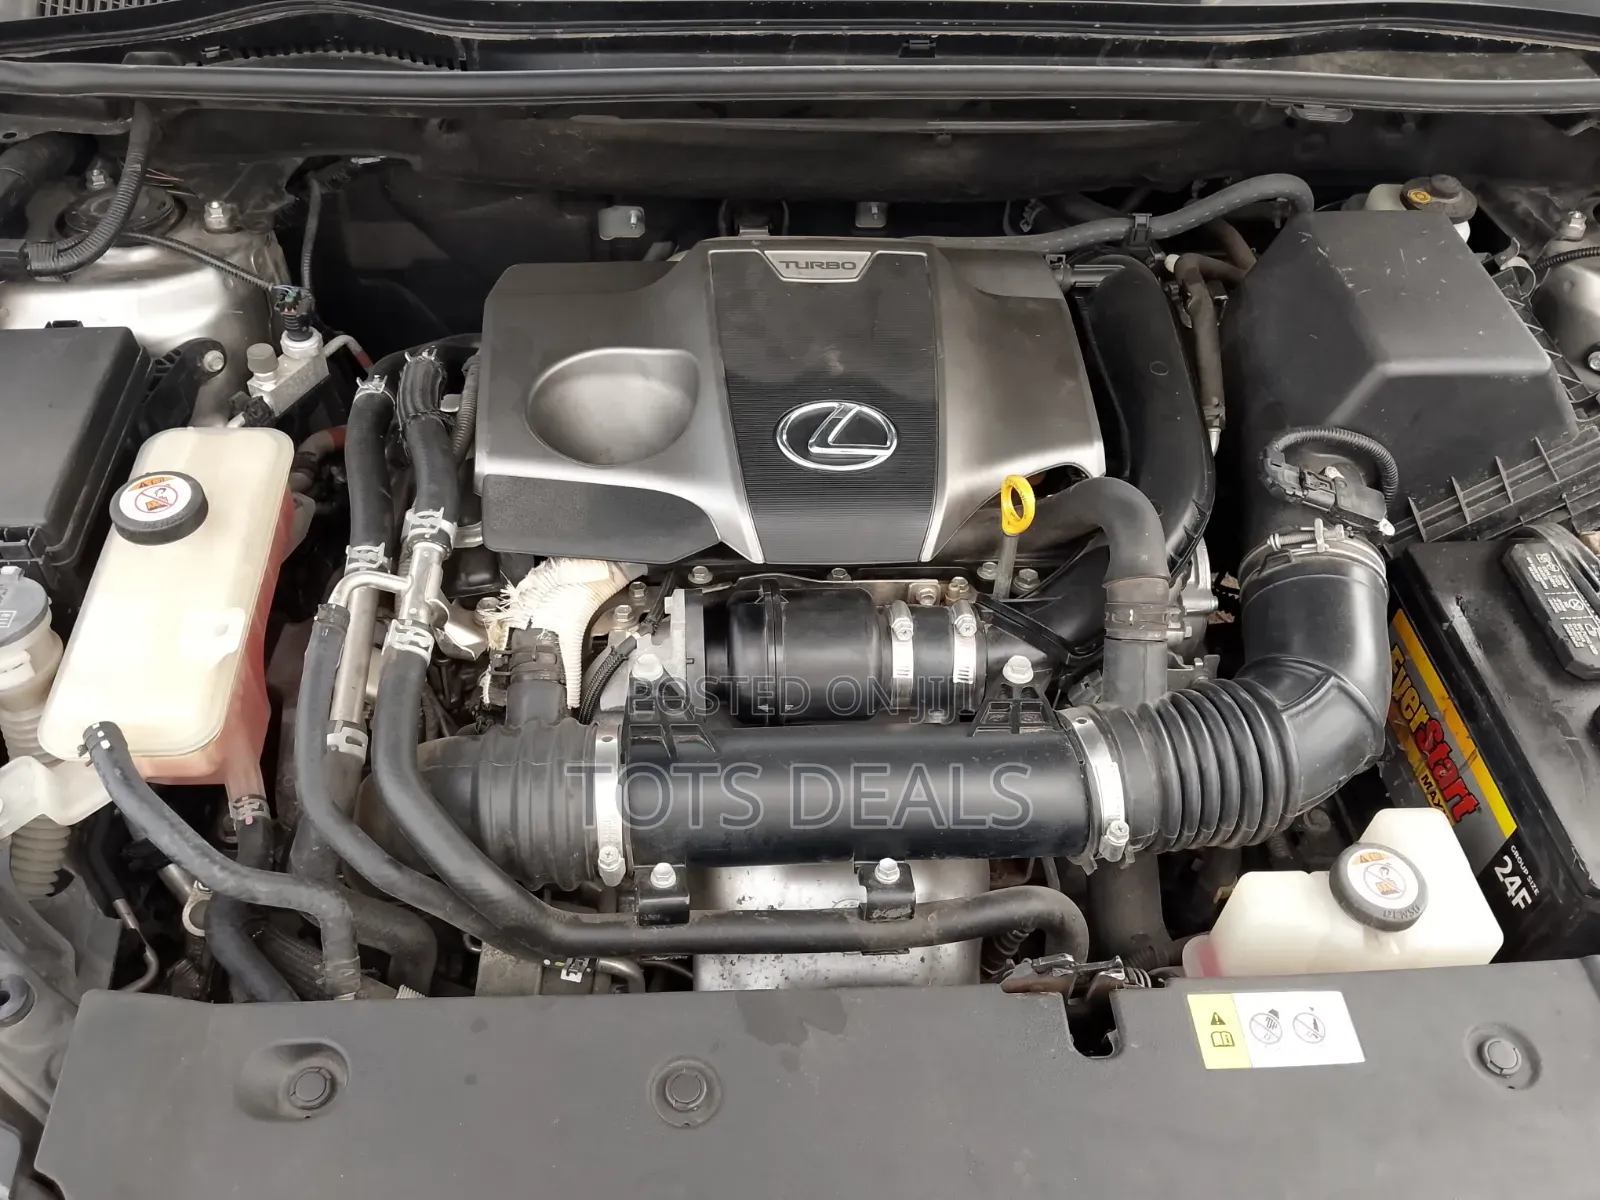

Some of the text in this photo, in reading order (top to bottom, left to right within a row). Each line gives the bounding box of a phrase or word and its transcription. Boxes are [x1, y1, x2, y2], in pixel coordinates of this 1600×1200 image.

[778, 260, 857, 270] TURBO
[1494, 854, 1532, 910] 24F
[1510, 845, 1540, 896] GROUP SIZE
